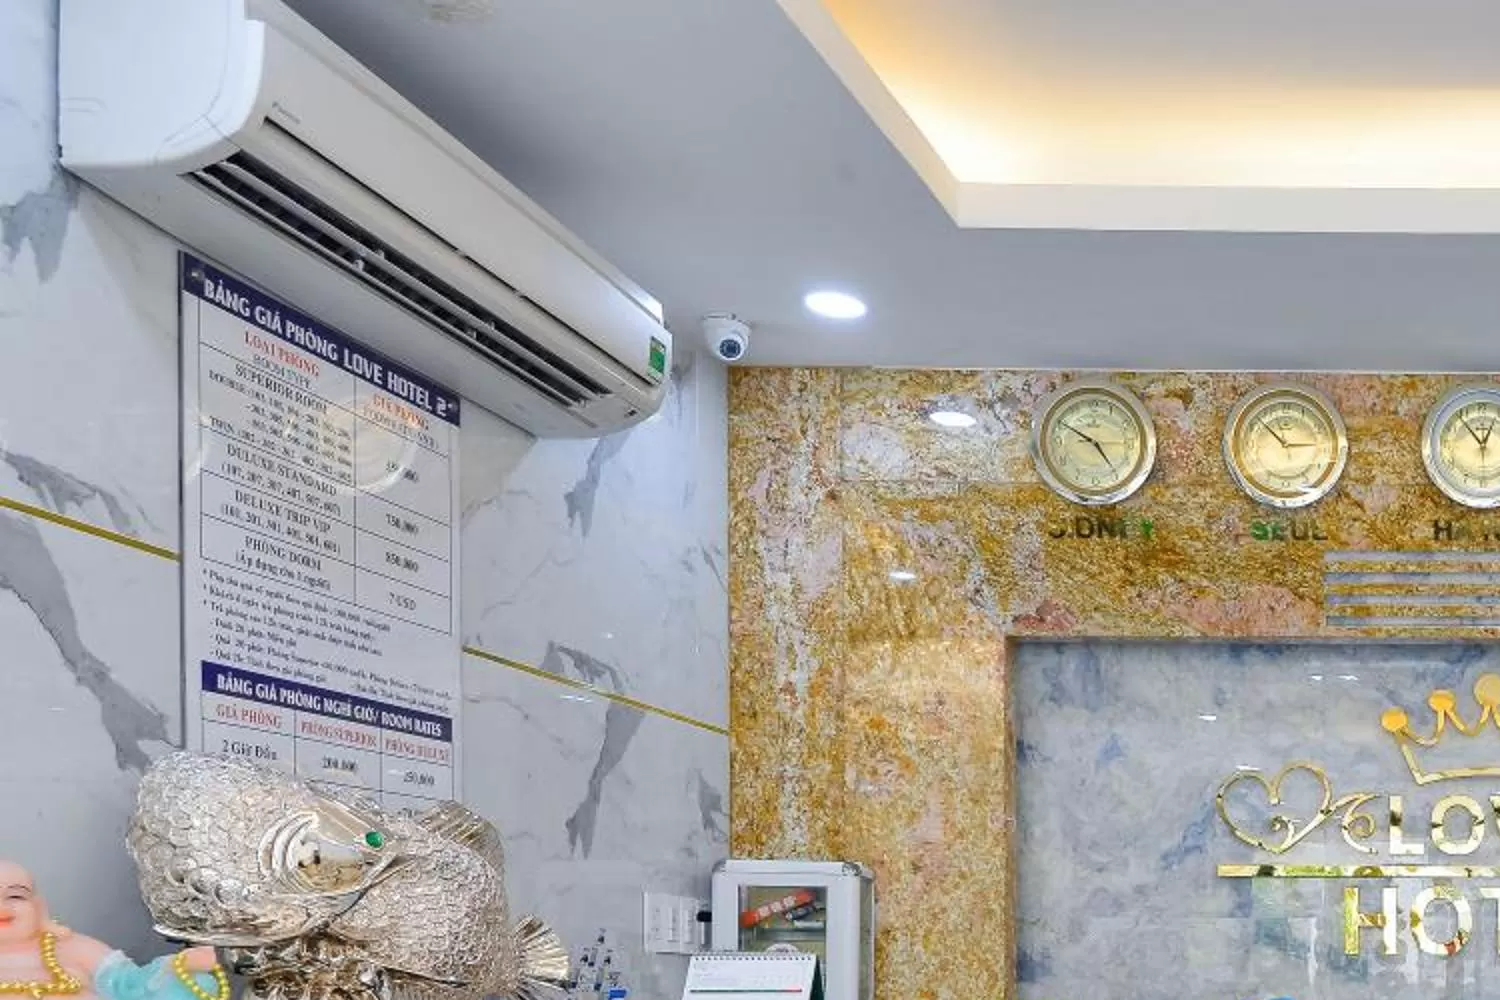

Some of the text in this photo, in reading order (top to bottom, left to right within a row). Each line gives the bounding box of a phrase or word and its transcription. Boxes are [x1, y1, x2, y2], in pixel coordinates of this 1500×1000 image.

[203, 278, 448, 417] BẢNG GIÁ PHÒNG LOVE HOTEL 2
[216, 668, 253, 697] BẢNG
[255, 678, 277, 702] GIÁ
[278, 683, 320, 712] PHÒNG
